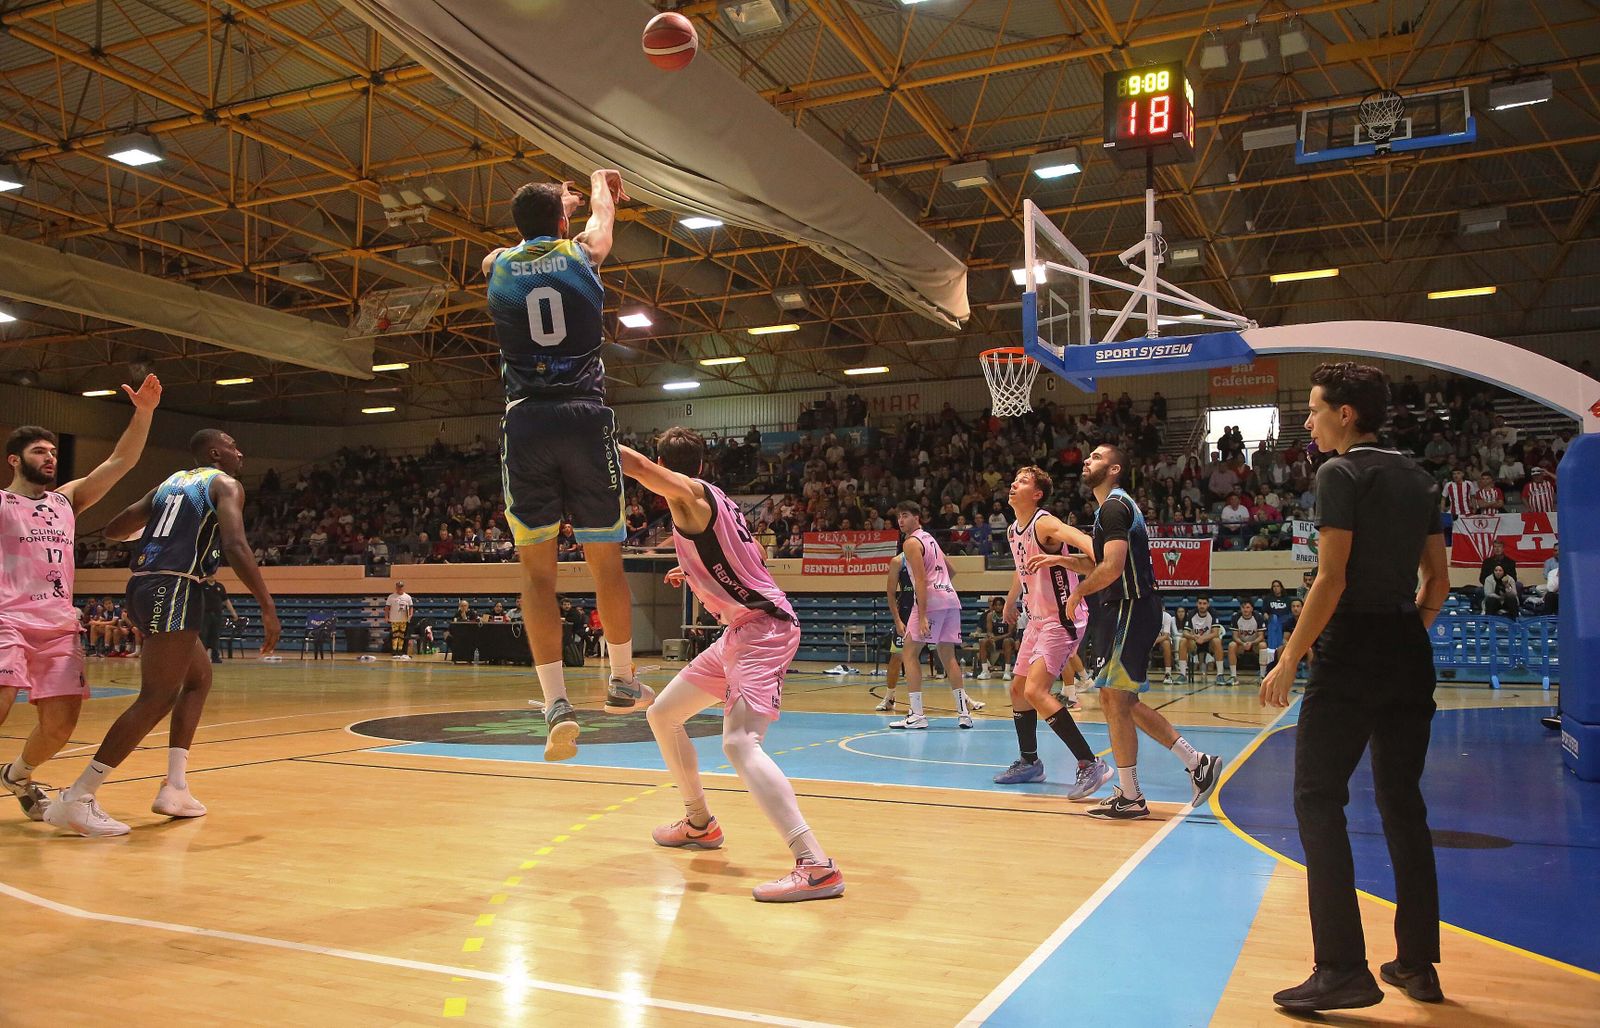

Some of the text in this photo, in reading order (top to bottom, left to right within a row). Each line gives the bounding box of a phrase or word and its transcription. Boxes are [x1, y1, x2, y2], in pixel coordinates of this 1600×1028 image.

[1128, 71, 1169, 95] 9:08
[1129, 96, 1169, 135] 18
[510, 256, 568, 276] SERGIO
[526, 287, 567, 347] 0
[1212, 374, 1275, 387] Cafeteria
[686, 404, 692, 416] B
[153, 494, 184, 538] 11
[31, 529, 66, 537] CLINICA
[818, 532, 880, 542] PEÑA 1912
[46, 548, 62, 563] 17
[805, 564, 845, 573] SENTIRE
